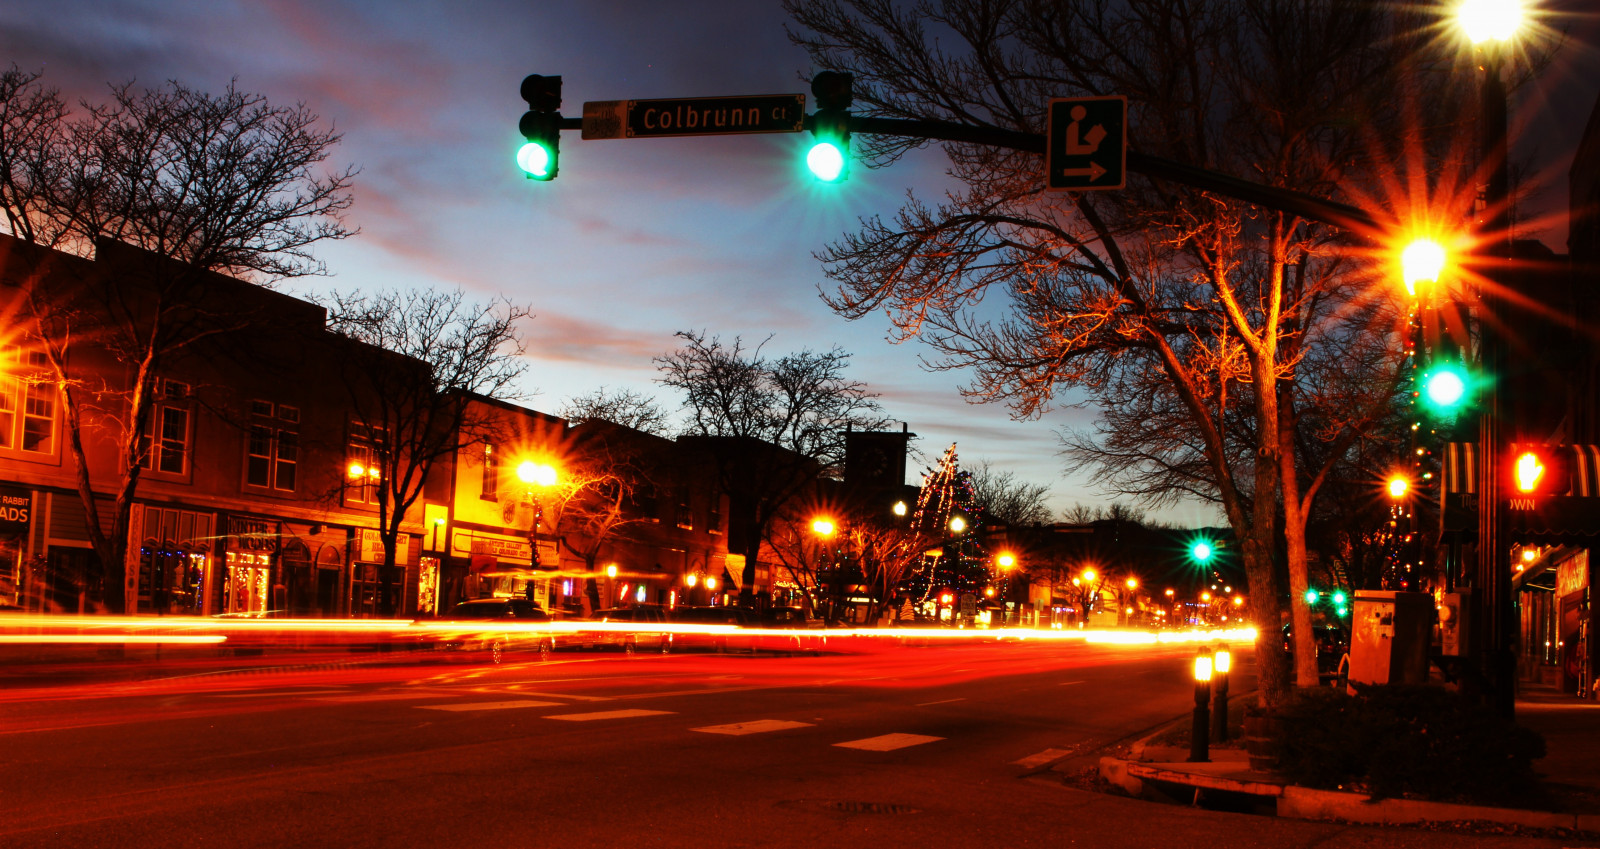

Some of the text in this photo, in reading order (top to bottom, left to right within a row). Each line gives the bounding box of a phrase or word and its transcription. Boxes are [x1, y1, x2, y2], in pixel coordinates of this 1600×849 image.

[643, 105, 761, 129] Colbrunn
[771, 106, 787, 120] Ct
[2, 495, 30, 506] RABBIT
